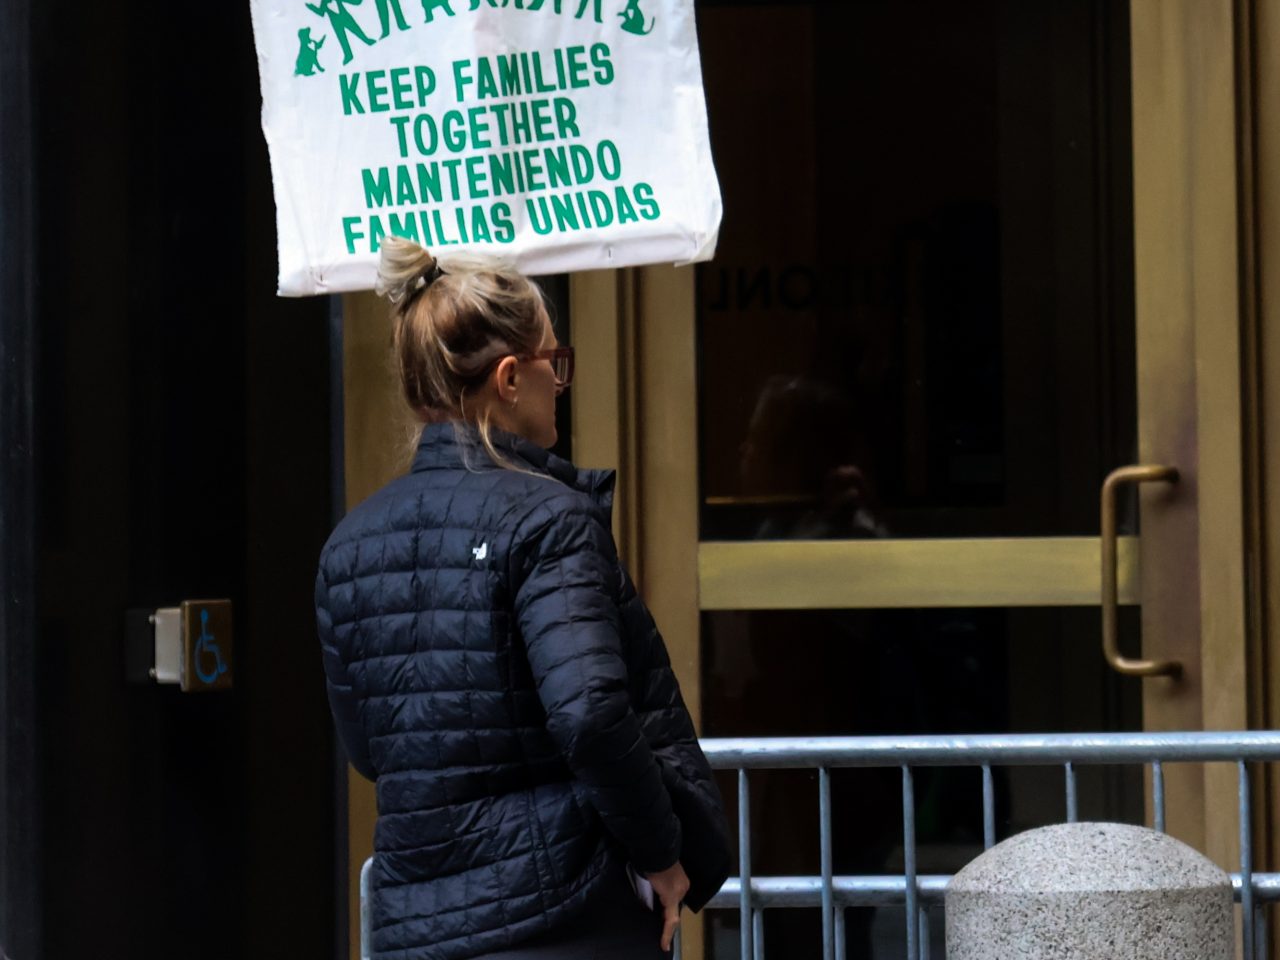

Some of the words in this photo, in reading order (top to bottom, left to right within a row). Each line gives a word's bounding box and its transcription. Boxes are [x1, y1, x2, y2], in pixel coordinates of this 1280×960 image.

[339, 65, 437, 116] KEEP
[453, 43, 615, 102] FAMILIES
[390, 97, 580, 158] TOGETHER
[362, 140, 622, 209] MANTENIENDO
[342, 202, 515, 254] FAMILIAS
[529, 182, 660, 235] UNIDAS
